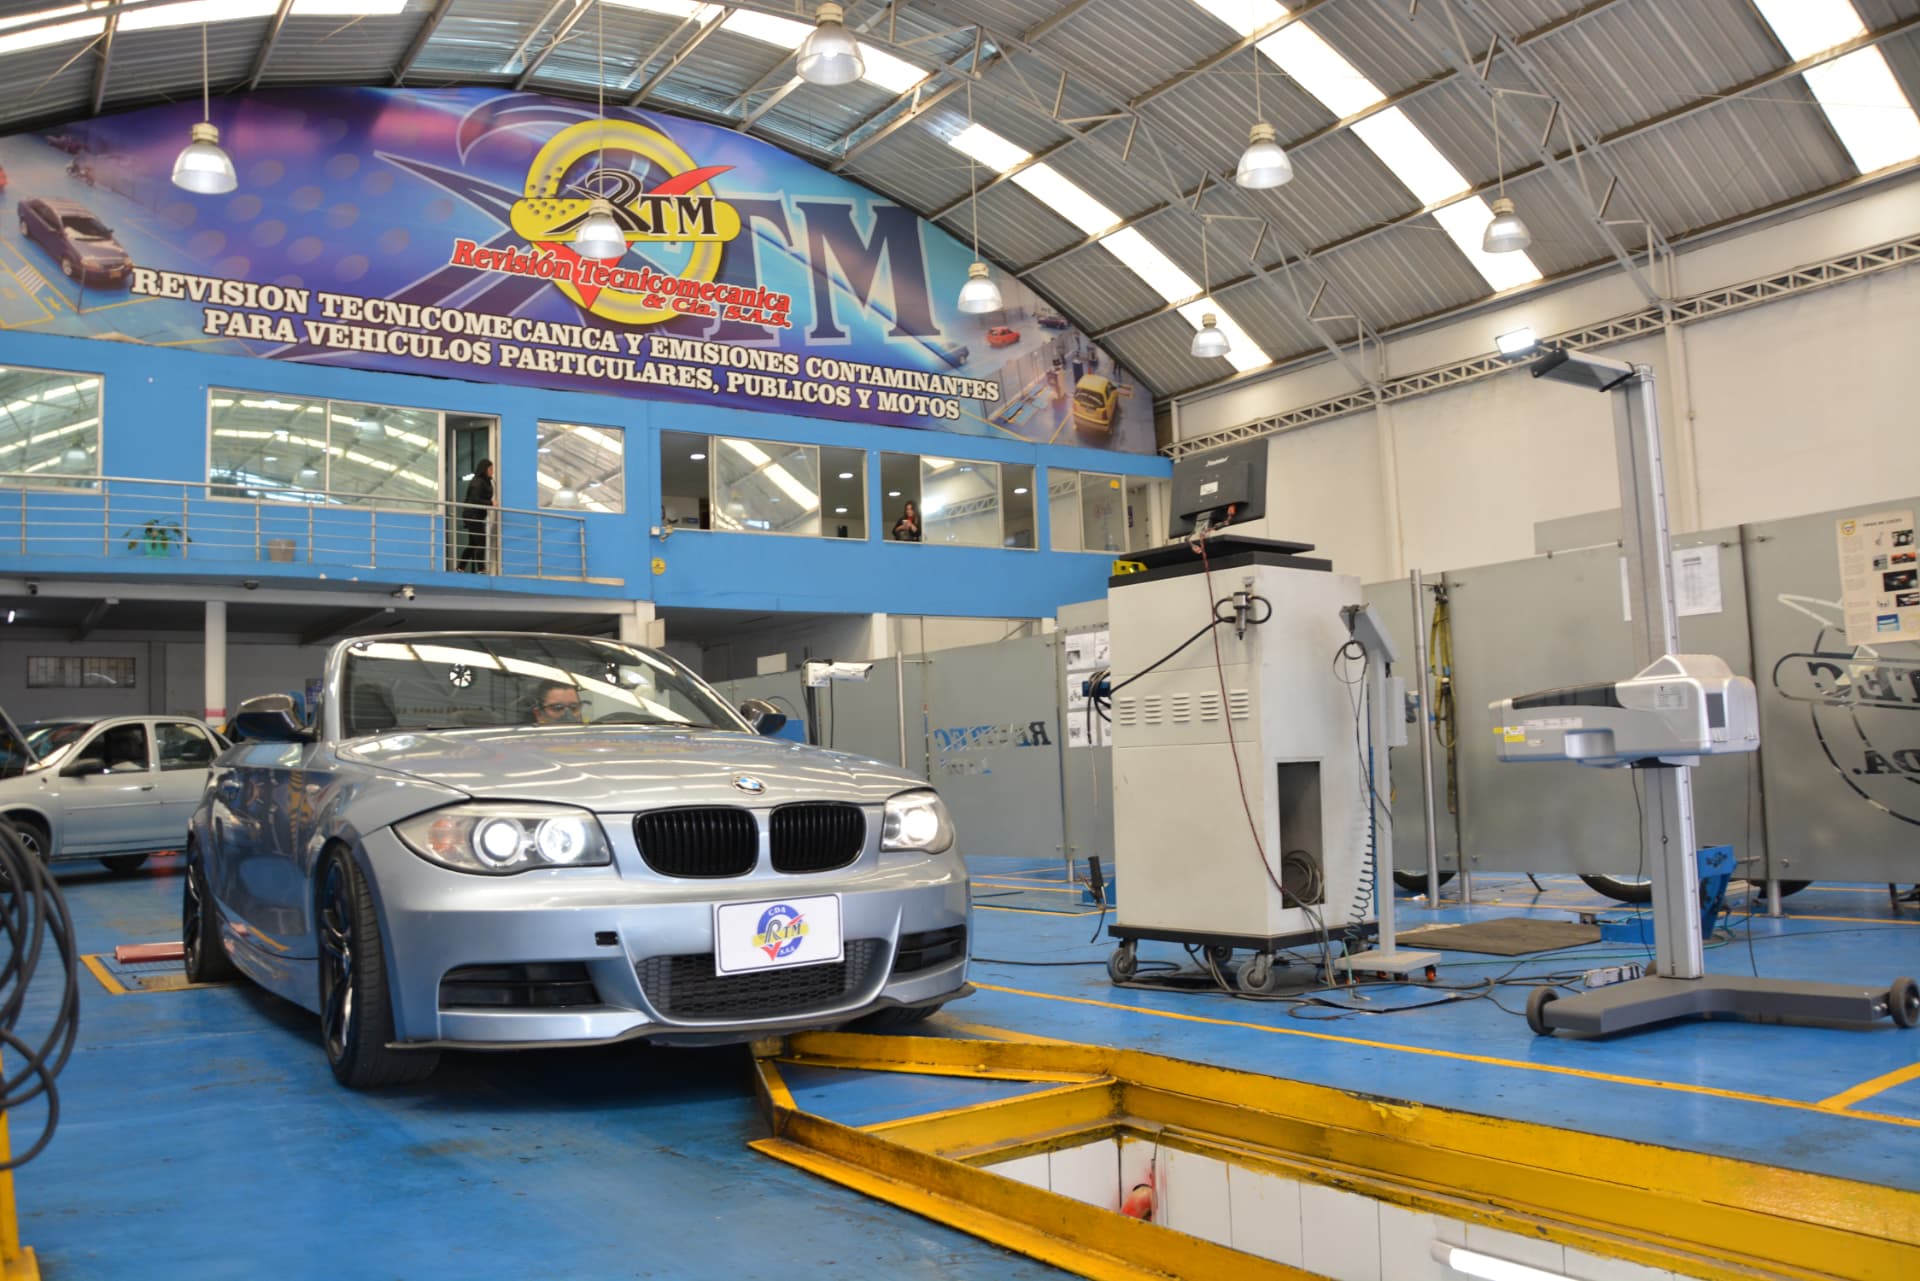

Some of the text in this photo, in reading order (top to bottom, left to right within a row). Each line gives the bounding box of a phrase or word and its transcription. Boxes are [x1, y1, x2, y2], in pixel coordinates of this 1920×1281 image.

[544, 168, 719, 237] RTM
[451, 239, 791, 313] Revisión Tecnicomecanica
[642, 293, 666, 310] &
[131, 266, 1000, 402] REVISION TECNICOMECANICA Y EMISIONES CONTAMINANTES
[204, 308, 962, 421] PARA VEHICULOS PARTICULARES, PUBLICOS Y MOTOS
